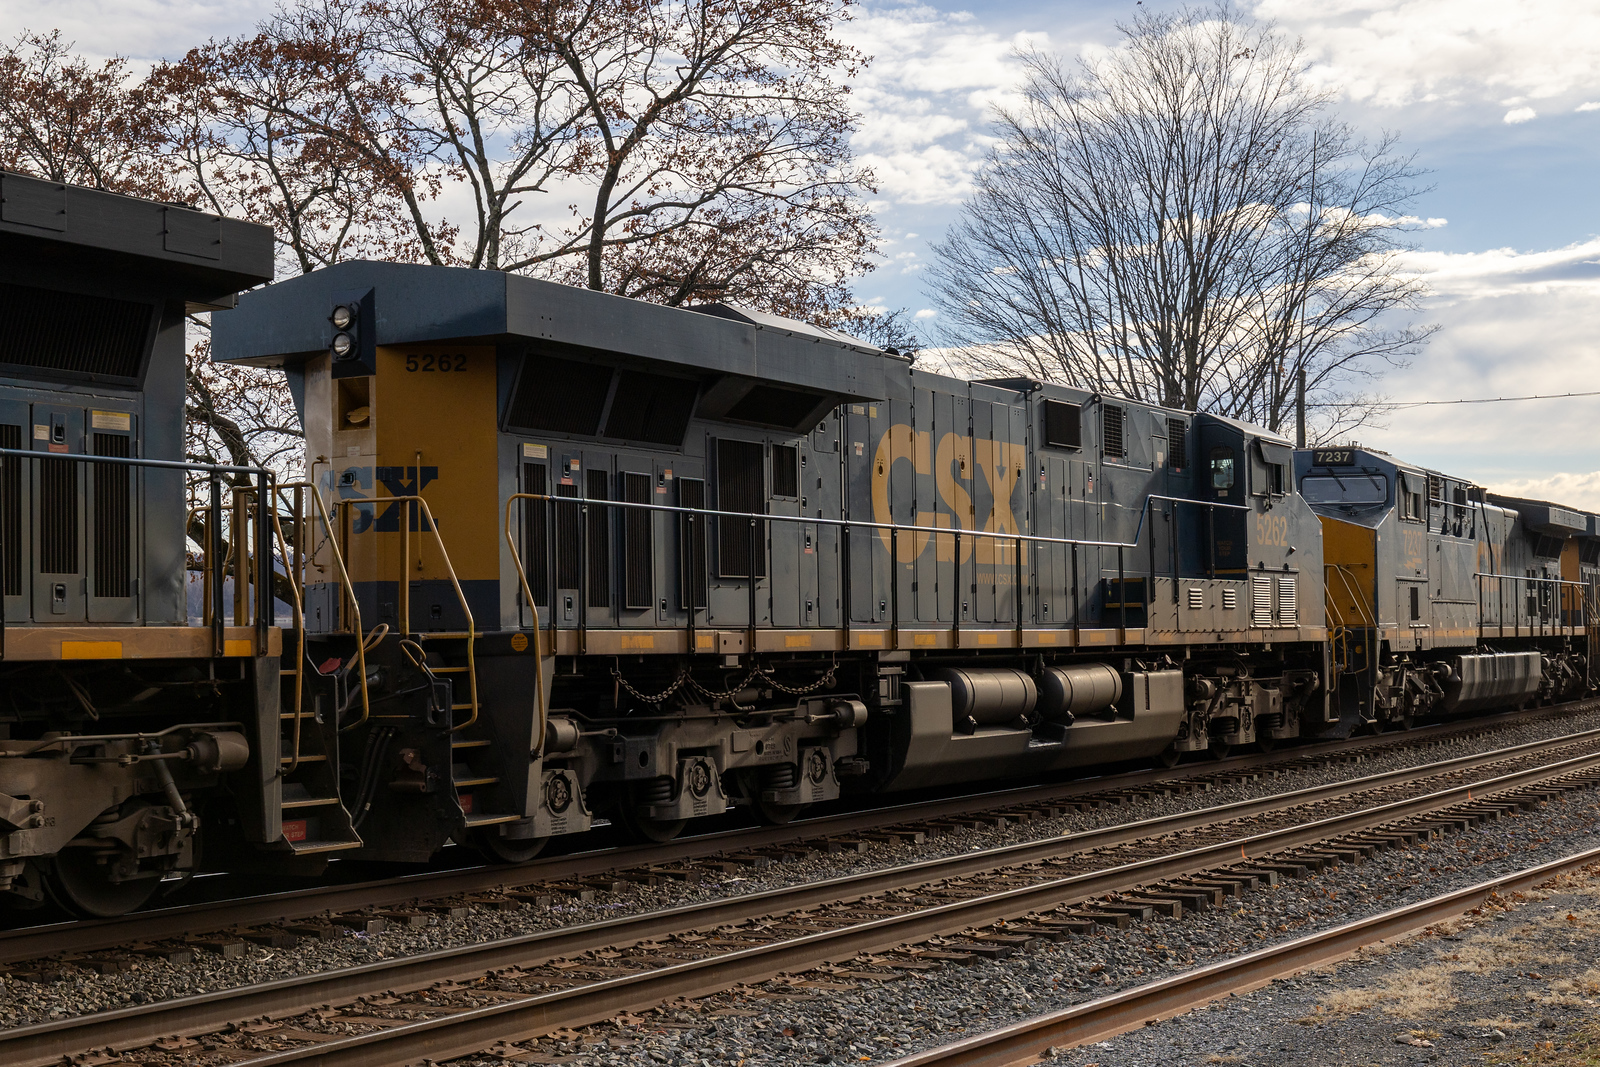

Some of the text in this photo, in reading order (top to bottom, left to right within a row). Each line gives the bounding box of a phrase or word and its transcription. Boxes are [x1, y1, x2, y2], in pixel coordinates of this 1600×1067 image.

[405, 354, 467, 373] 5262
[1316, 451, 1350, 463] 7237
[871, 423, 1028, 566] CSX
[1256, 513, 1288, 547] 5262
[1402, 530, 1423, 556] 7237
[976, 573, 1028, 586] WWW.CSX.CM
